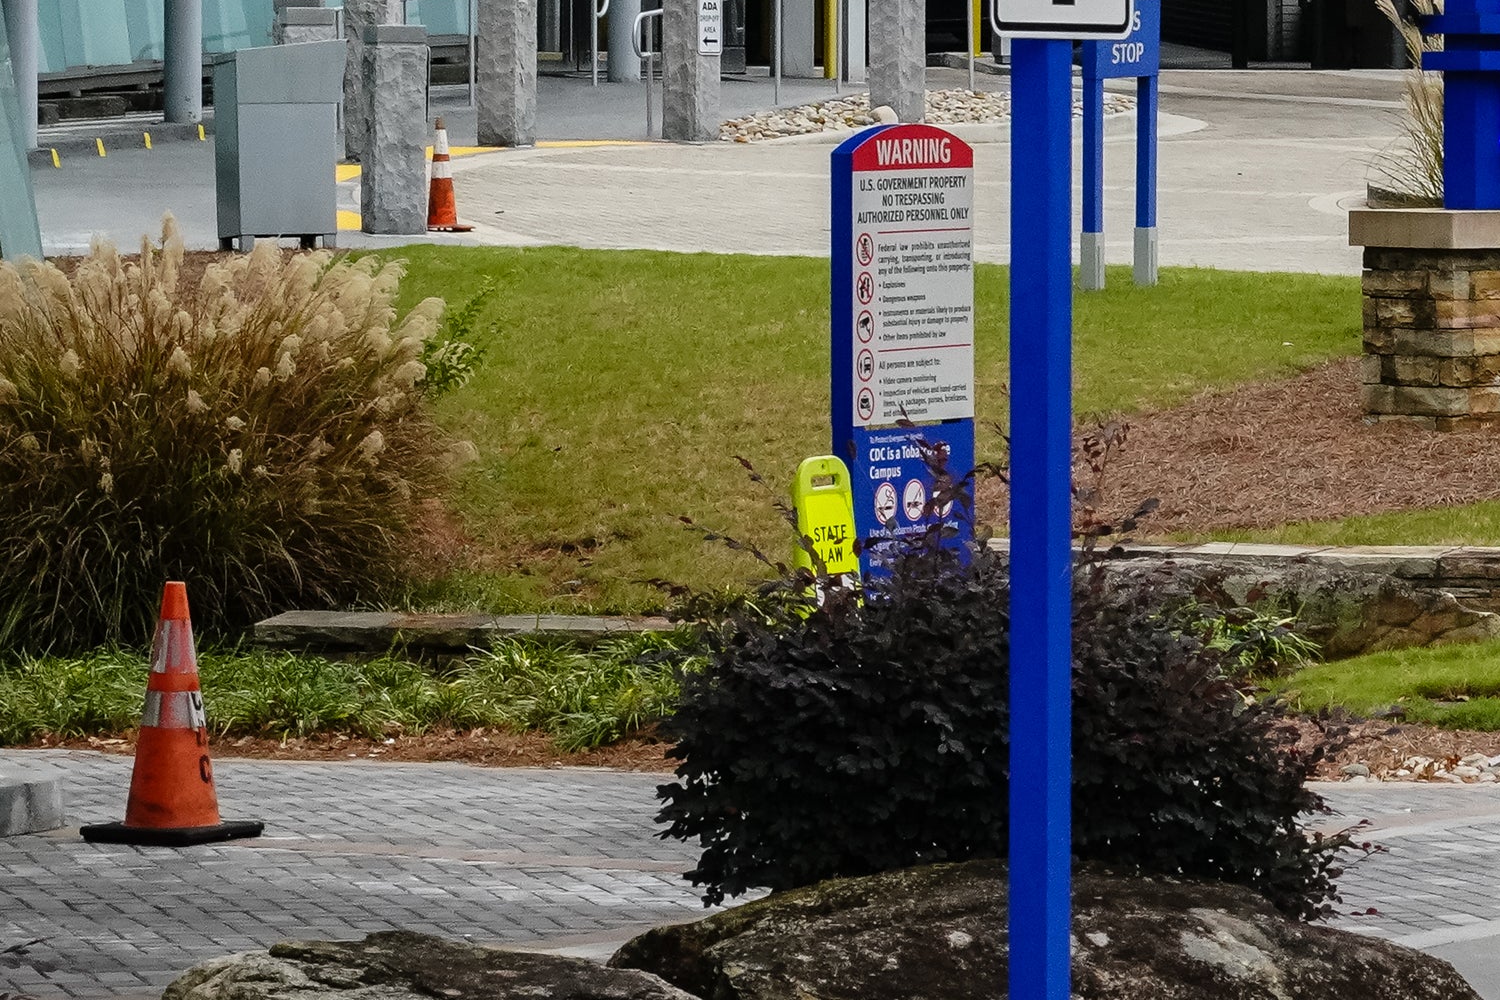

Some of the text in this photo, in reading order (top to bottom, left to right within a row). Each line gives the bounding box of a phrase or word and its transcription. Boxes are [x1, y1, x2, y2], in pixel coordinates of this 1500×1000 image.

[702, 1, 718, 11] ADA
[1112, 42, 1144, 64] STOP
[876, 138, 951, 166] WARNING
[860, 175, 967, 192] U.S. GOVERNMENT PROPERTY
[882, 192, 945, 206] NO TRESPASSING
[857, 207, 969, 224] AUTHORIZED PERSONNEL ONLY
[870, 447, 885, 461] CDC
[887, 447, 894, 460] is
[896, 449, 900, 459] a
[869, 465, 902, 481] Campus
[814, 524, 847, 542] STATE
[821, 546, 843, 563] LAW
